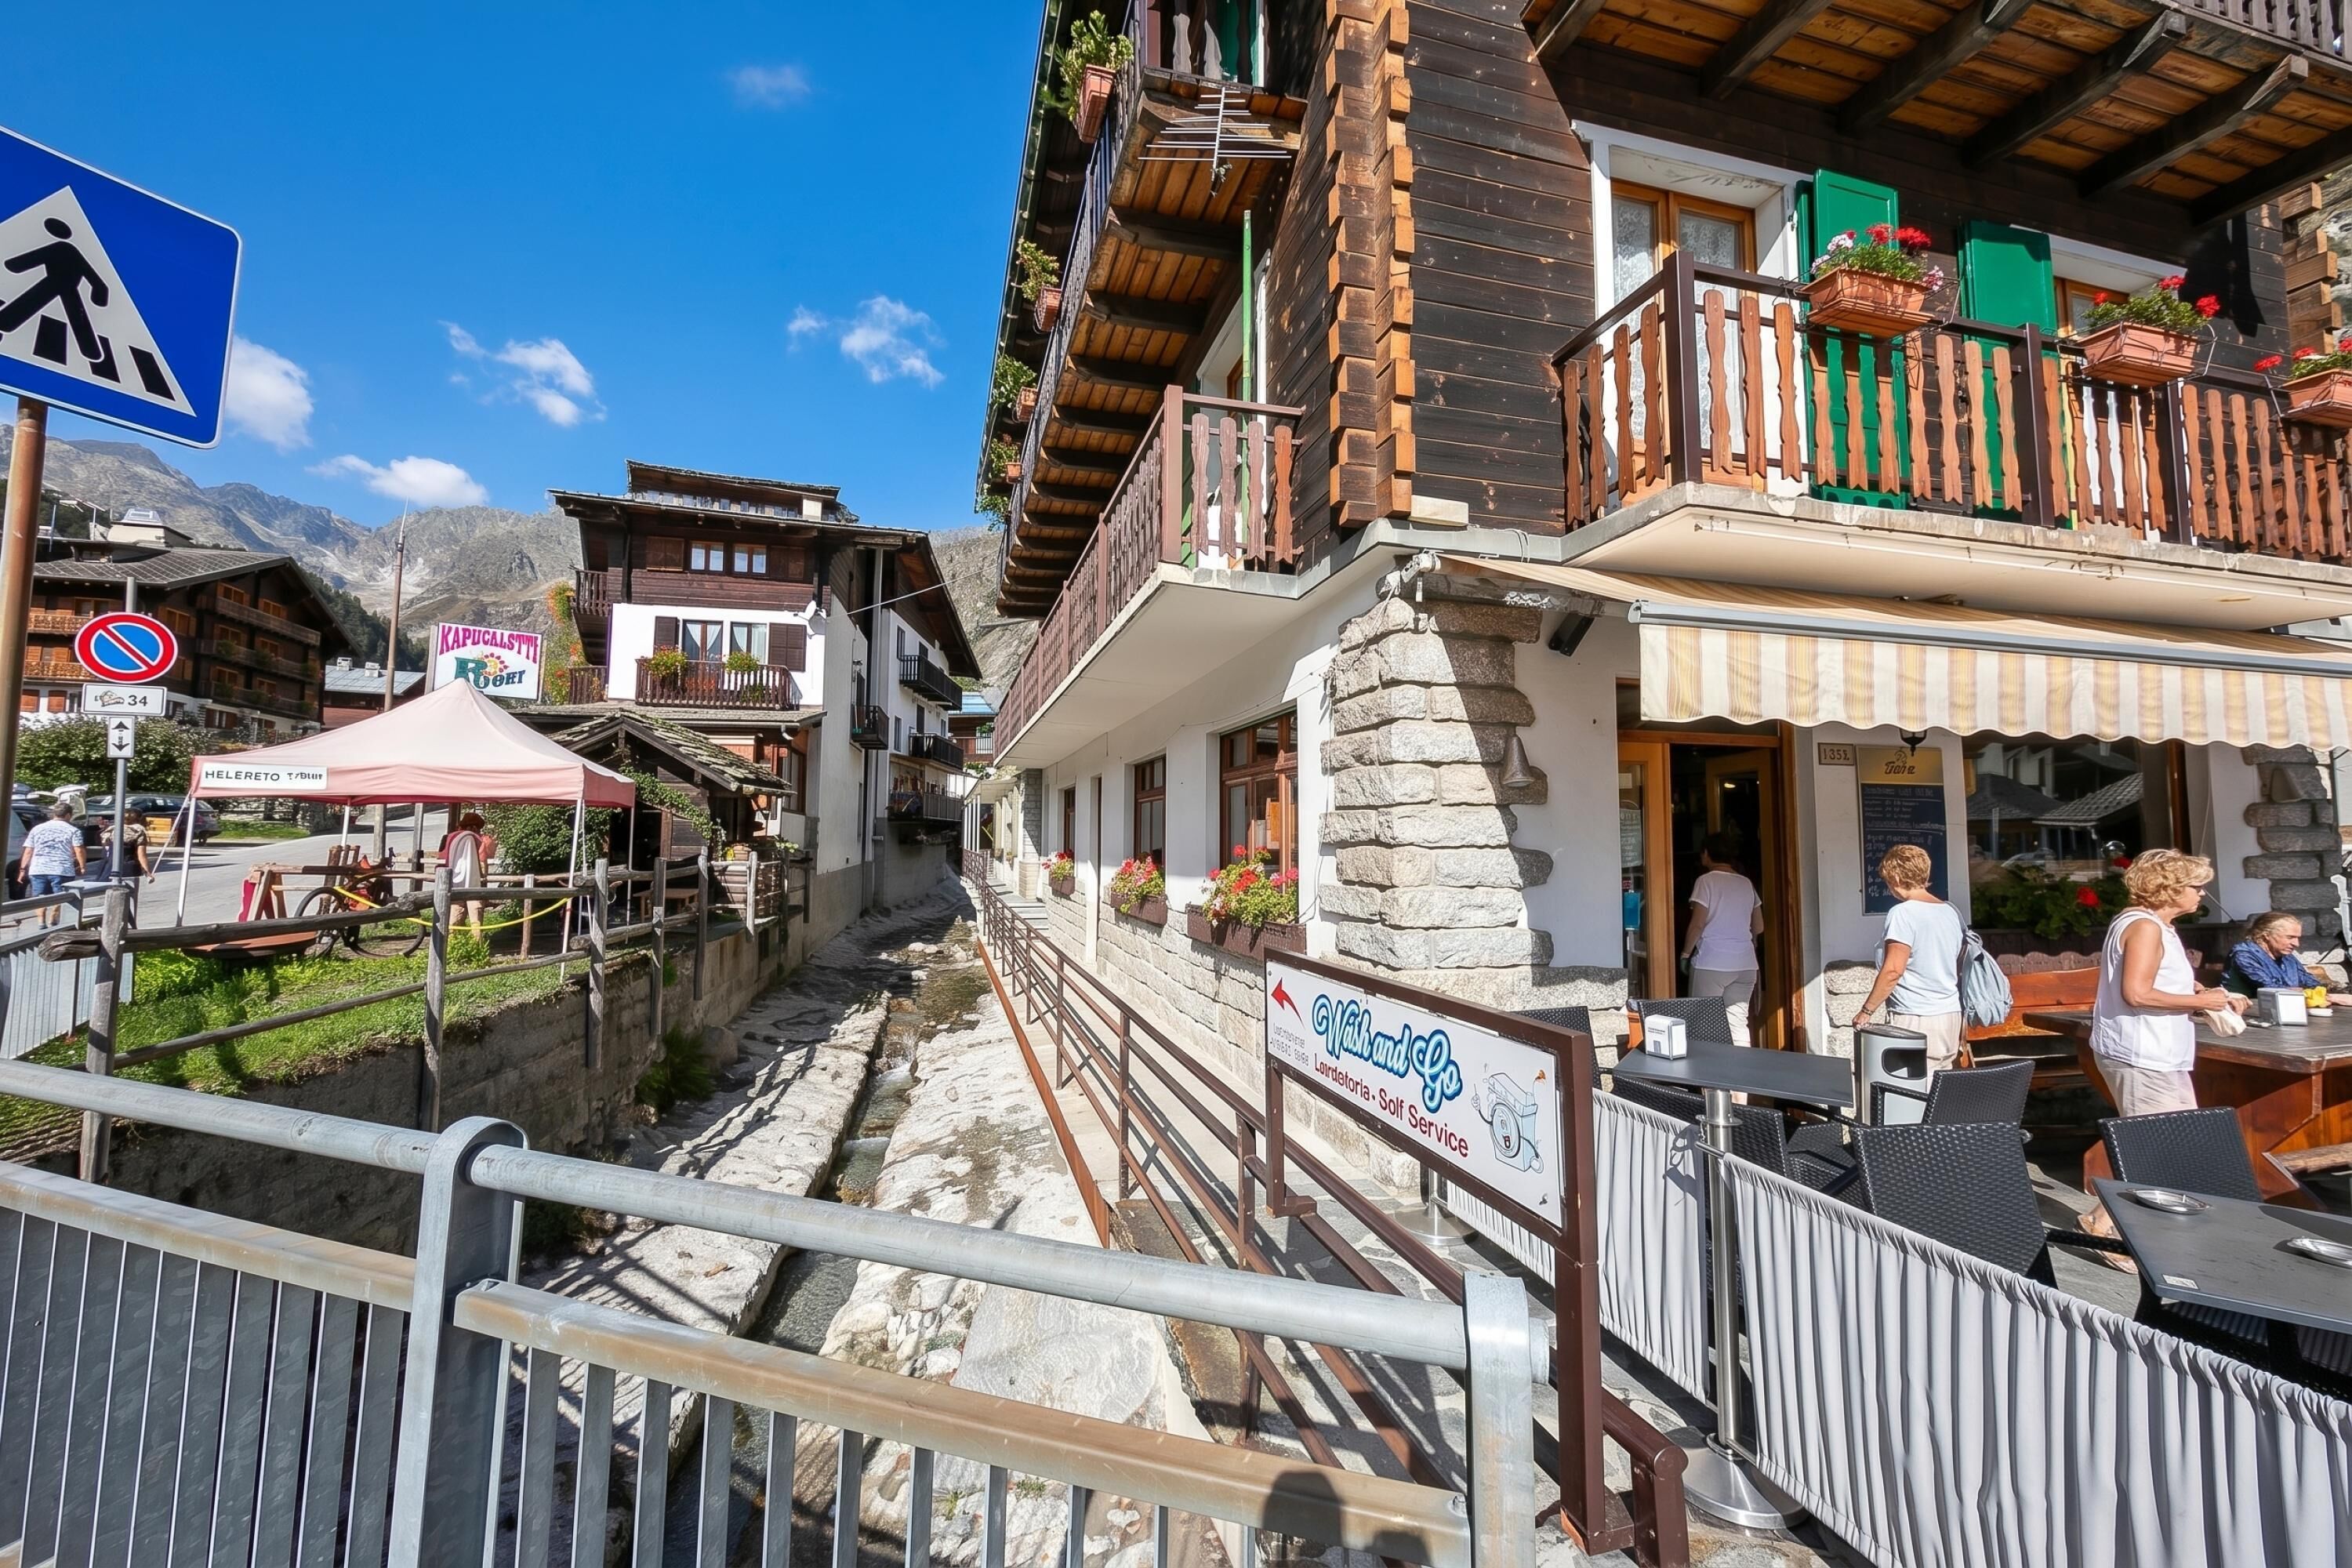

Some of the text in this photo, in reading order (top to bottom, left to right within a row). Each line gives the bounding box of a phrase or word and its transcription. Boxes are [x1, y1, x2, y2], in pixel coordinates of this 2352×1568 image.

[128, 695, 147, 706] 34
[205, 770, 280, 782] HELERETO
[1312, 993, 1372, 1059] Wash
[1370, 1024, 1412, 1079] and
[1410, 1029, 1463, 1113] Go
[1408, 1104, 1469, 1158] Service
